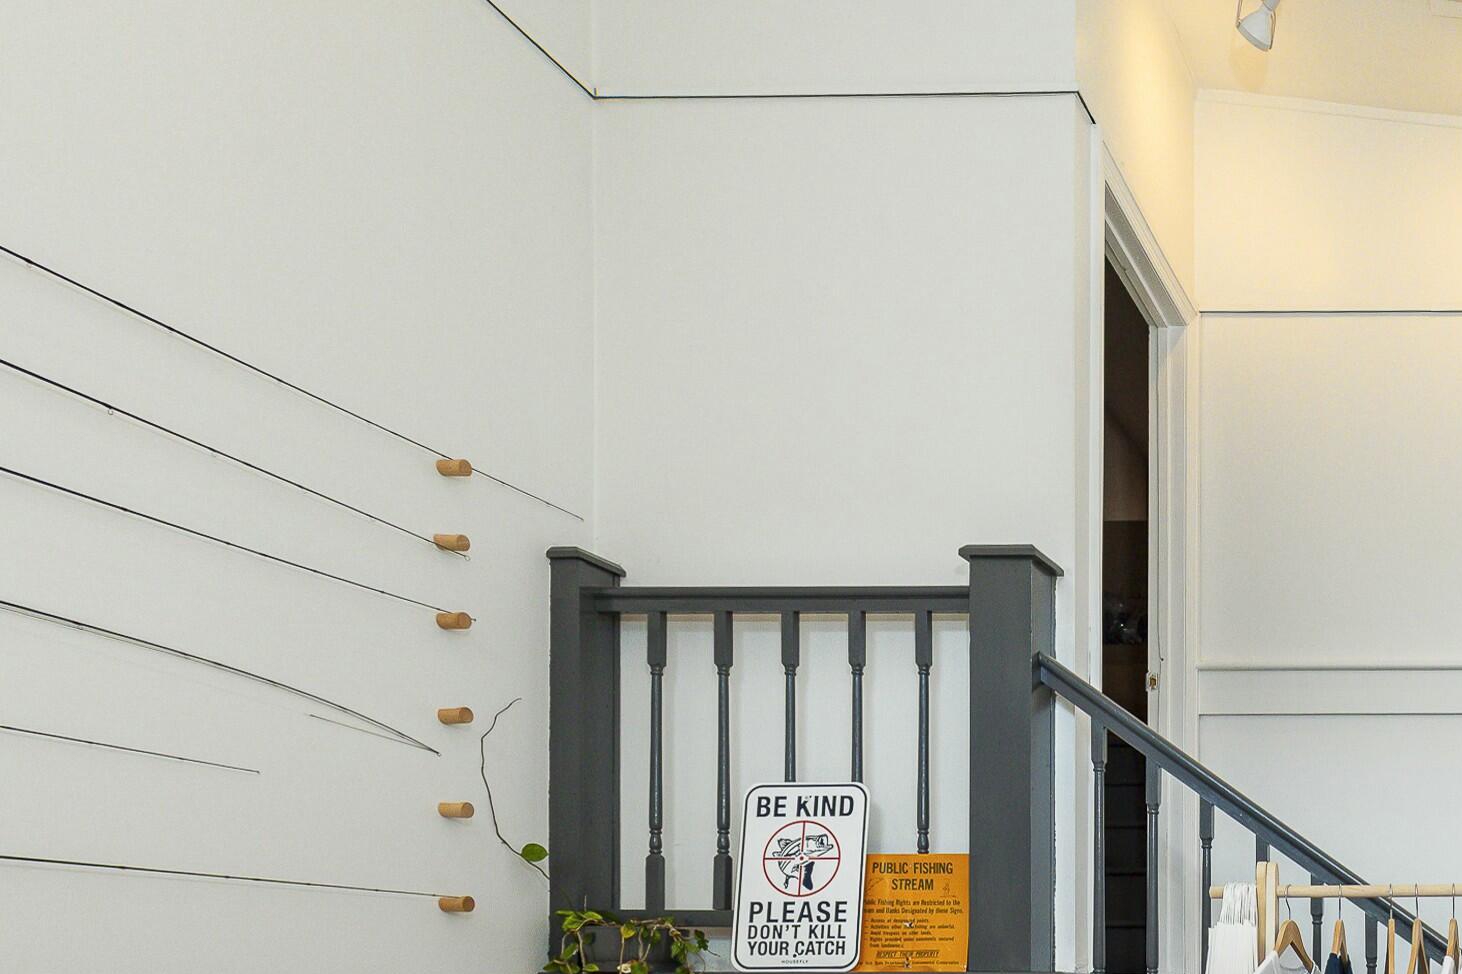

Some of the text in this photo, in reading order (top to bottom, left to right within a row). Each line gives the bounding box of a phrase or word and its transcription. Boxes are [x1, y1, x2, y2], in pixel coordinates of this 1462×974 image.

[756, 795, 854, 817] BE KIND
[872, 862, 953, 874] PUBLIC FISHING
[892, 878, 934, 890] STREAM
[749, 901, 848, 923] PLEASE
[748, 924, 846, 940] DON'T KILL
[748, 940, 846, 956] YOUR CATCH
